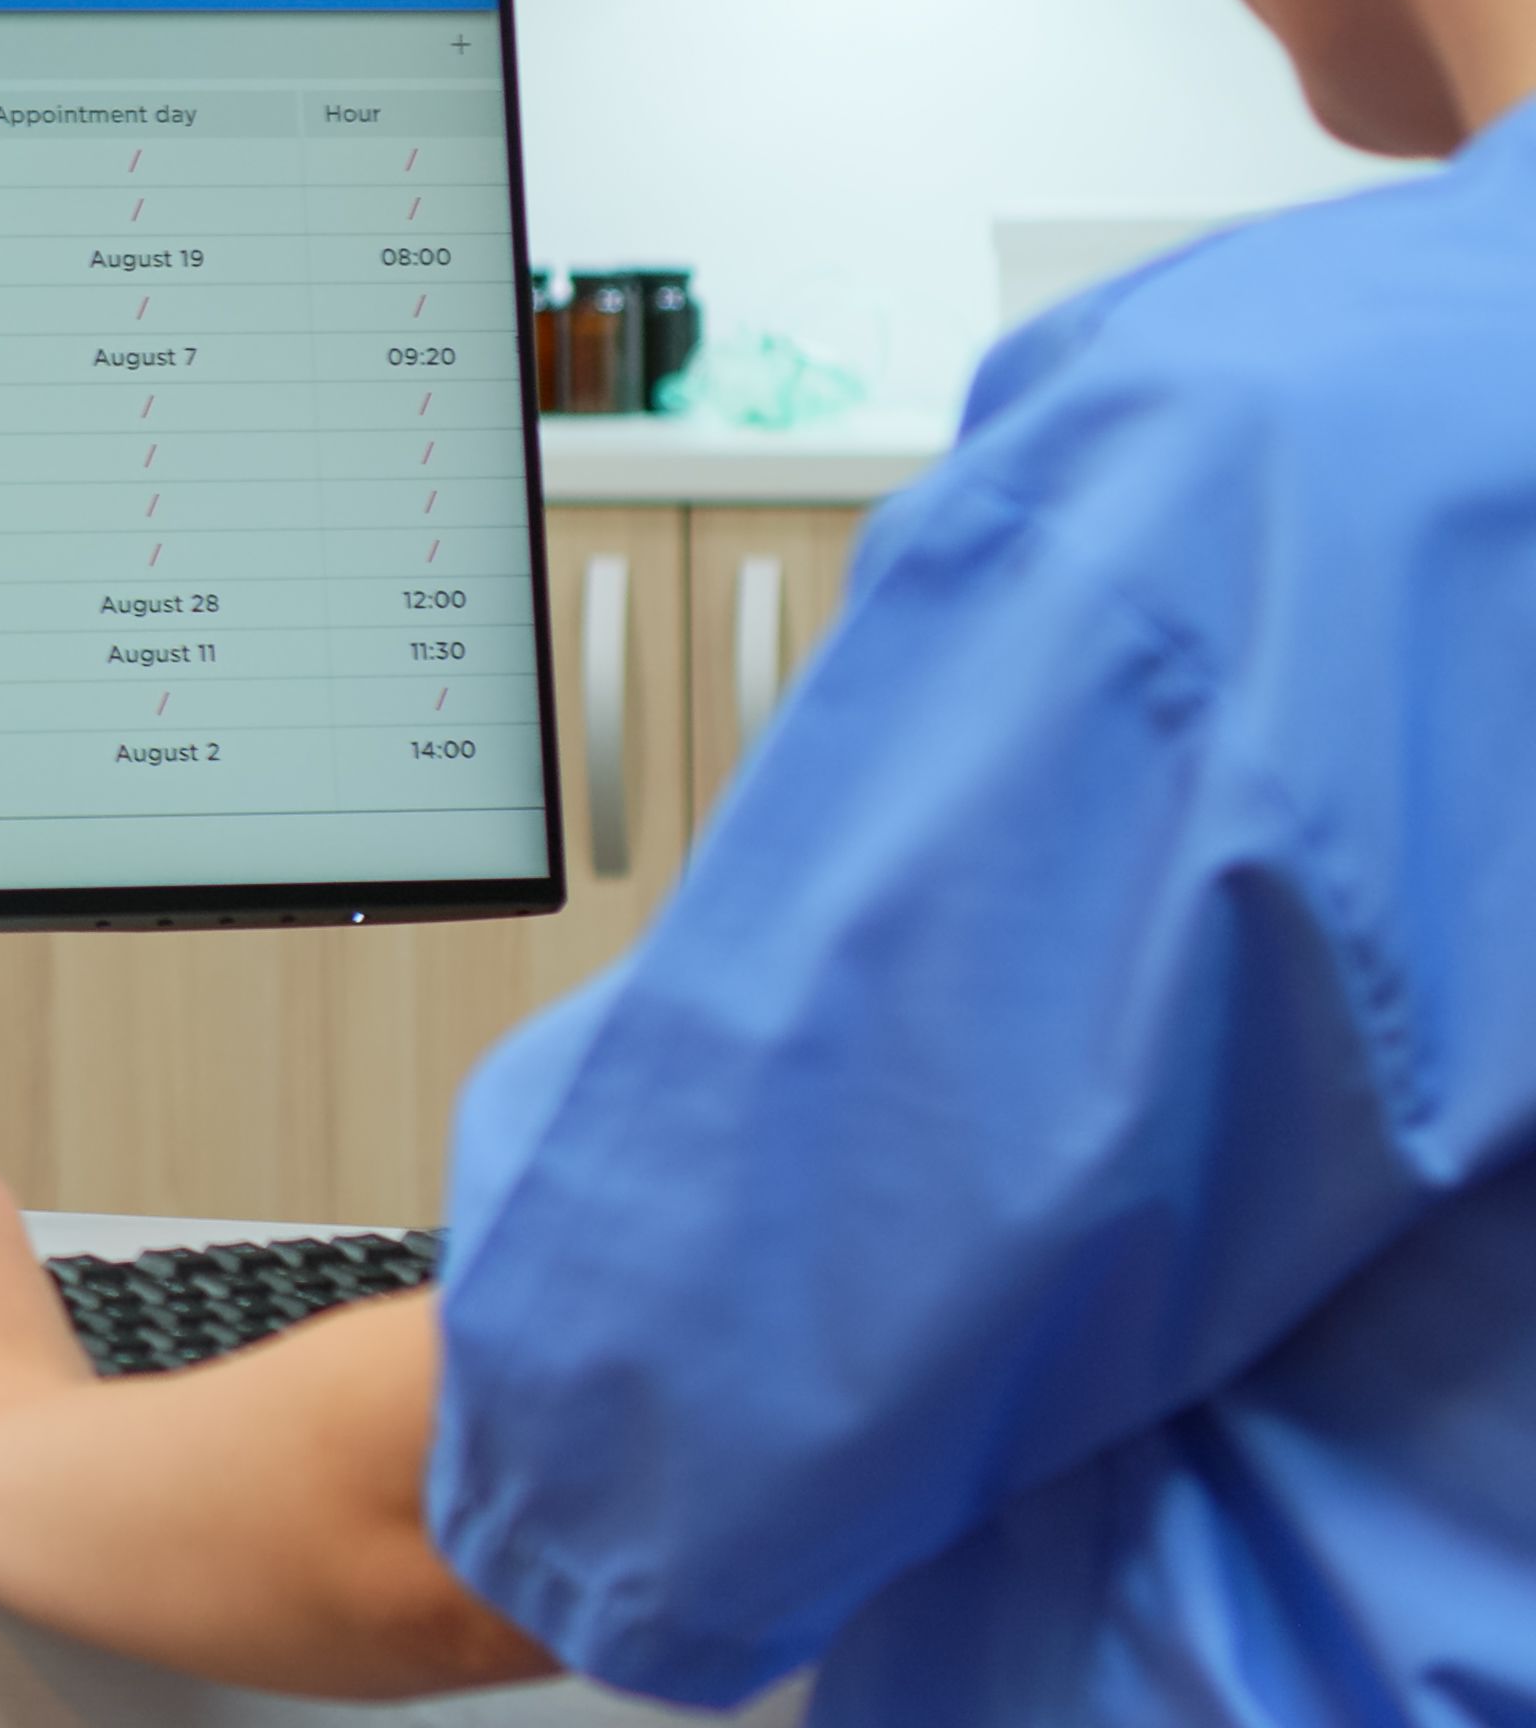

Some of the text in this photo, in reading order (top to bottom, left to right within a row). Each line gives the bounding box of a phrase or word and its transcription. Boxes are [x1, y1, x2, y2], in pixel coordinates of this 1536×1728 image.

[154, 104, 198, 128] day
[325, 104, 381, 123] Hour
[89, 248, 205, 273] August 19
[380, 247, 452, 267] 08:00
[92, 347, 198, 371] August 7
[386, 346, 457, 367] 09:20
[99, 593, 220, 618] August 28
[401, 589, 468, 610] 12:00
[107, 643, 216, 668] August 11
[409, 641, 467, 661] 11:30
[114, 741, 221, 767] August 2
[410, 739, 477, 760] 14:00
